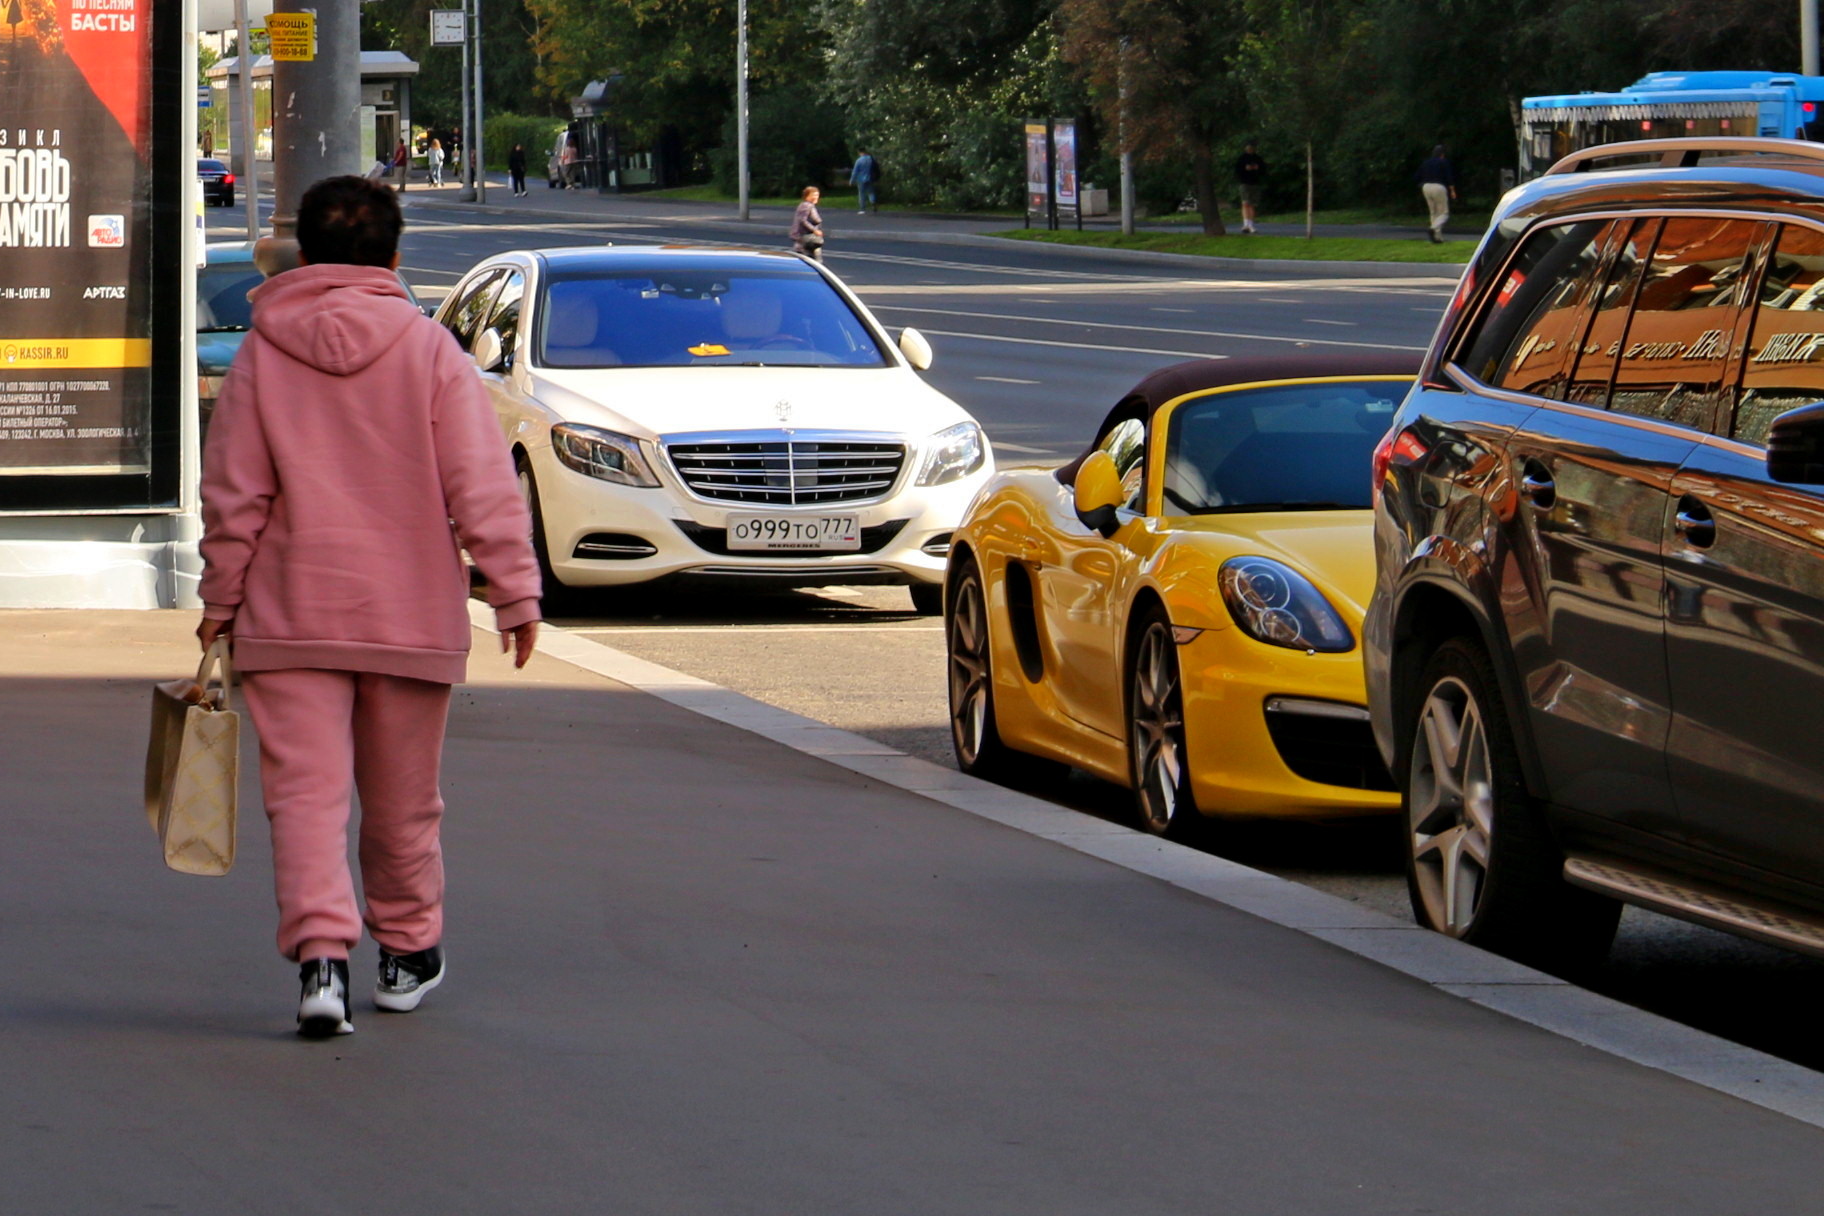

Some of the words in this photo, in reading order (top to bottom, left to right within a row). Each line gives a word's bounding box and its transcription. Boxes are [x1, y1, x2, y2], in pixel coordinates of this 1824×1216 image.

[71, 13, 135, 31] БАСТЫ
[83, 286, 126, 299] АРТГАЗ
[19, 347, 68, 359] KASSIR.RU
[49, 381, 65, 391] ОГРН
[52, 393, 60, 403] 27
[37, 406, 44, 415] ОТ
[2, 417, 33, 428] БИЛЕТНЫЙ
[822, 518, 852, 534] 777
